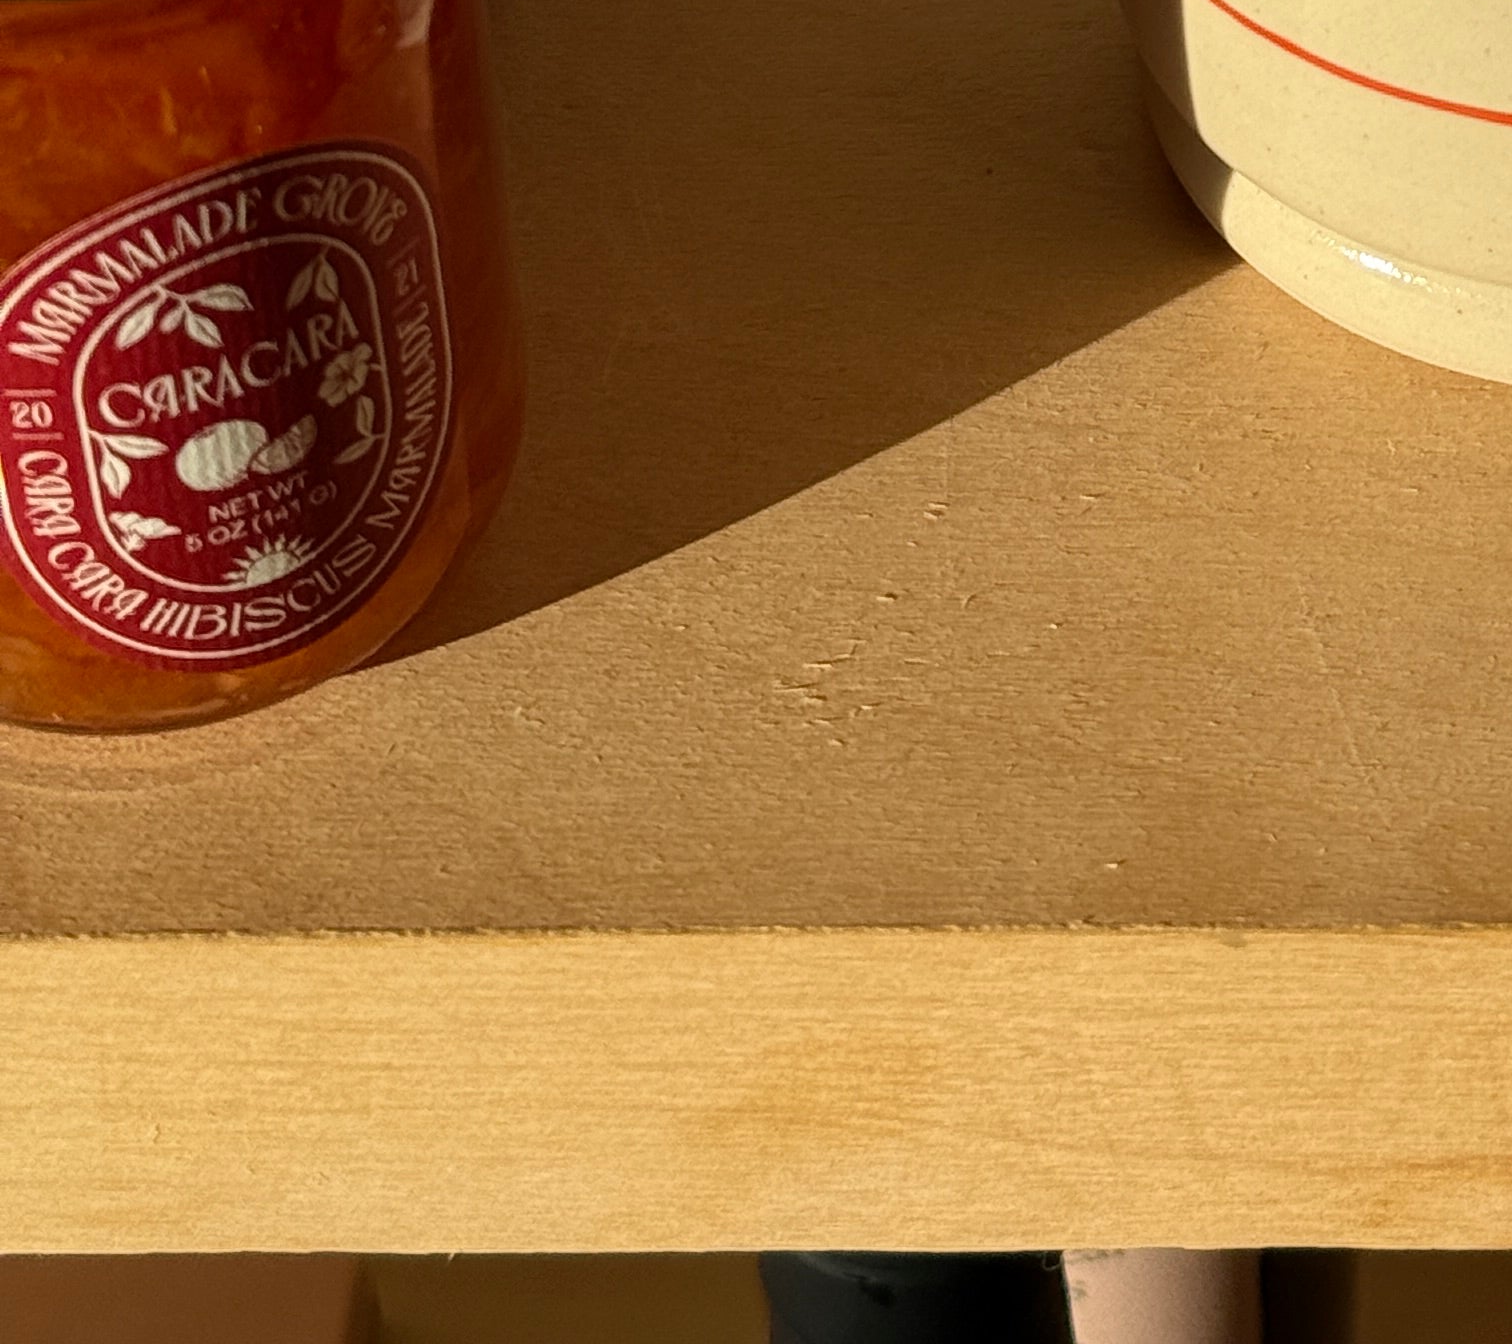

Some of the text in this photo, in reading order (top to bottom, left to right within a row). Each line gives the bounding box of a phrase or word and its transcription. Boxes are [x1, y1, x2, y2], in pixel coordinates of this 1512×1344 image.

[7, 173, 408, 366] MARMALADE GROVE
[11, 398, 53, 430] 20
[17, 451, 81, 537] CARA
[207, 518, 248, 546] OZ
[208, 470, 308, 524] NET WT
[48, 540, 147, 622] CARA
[141, 534, 377, 641] HIBISCUS
